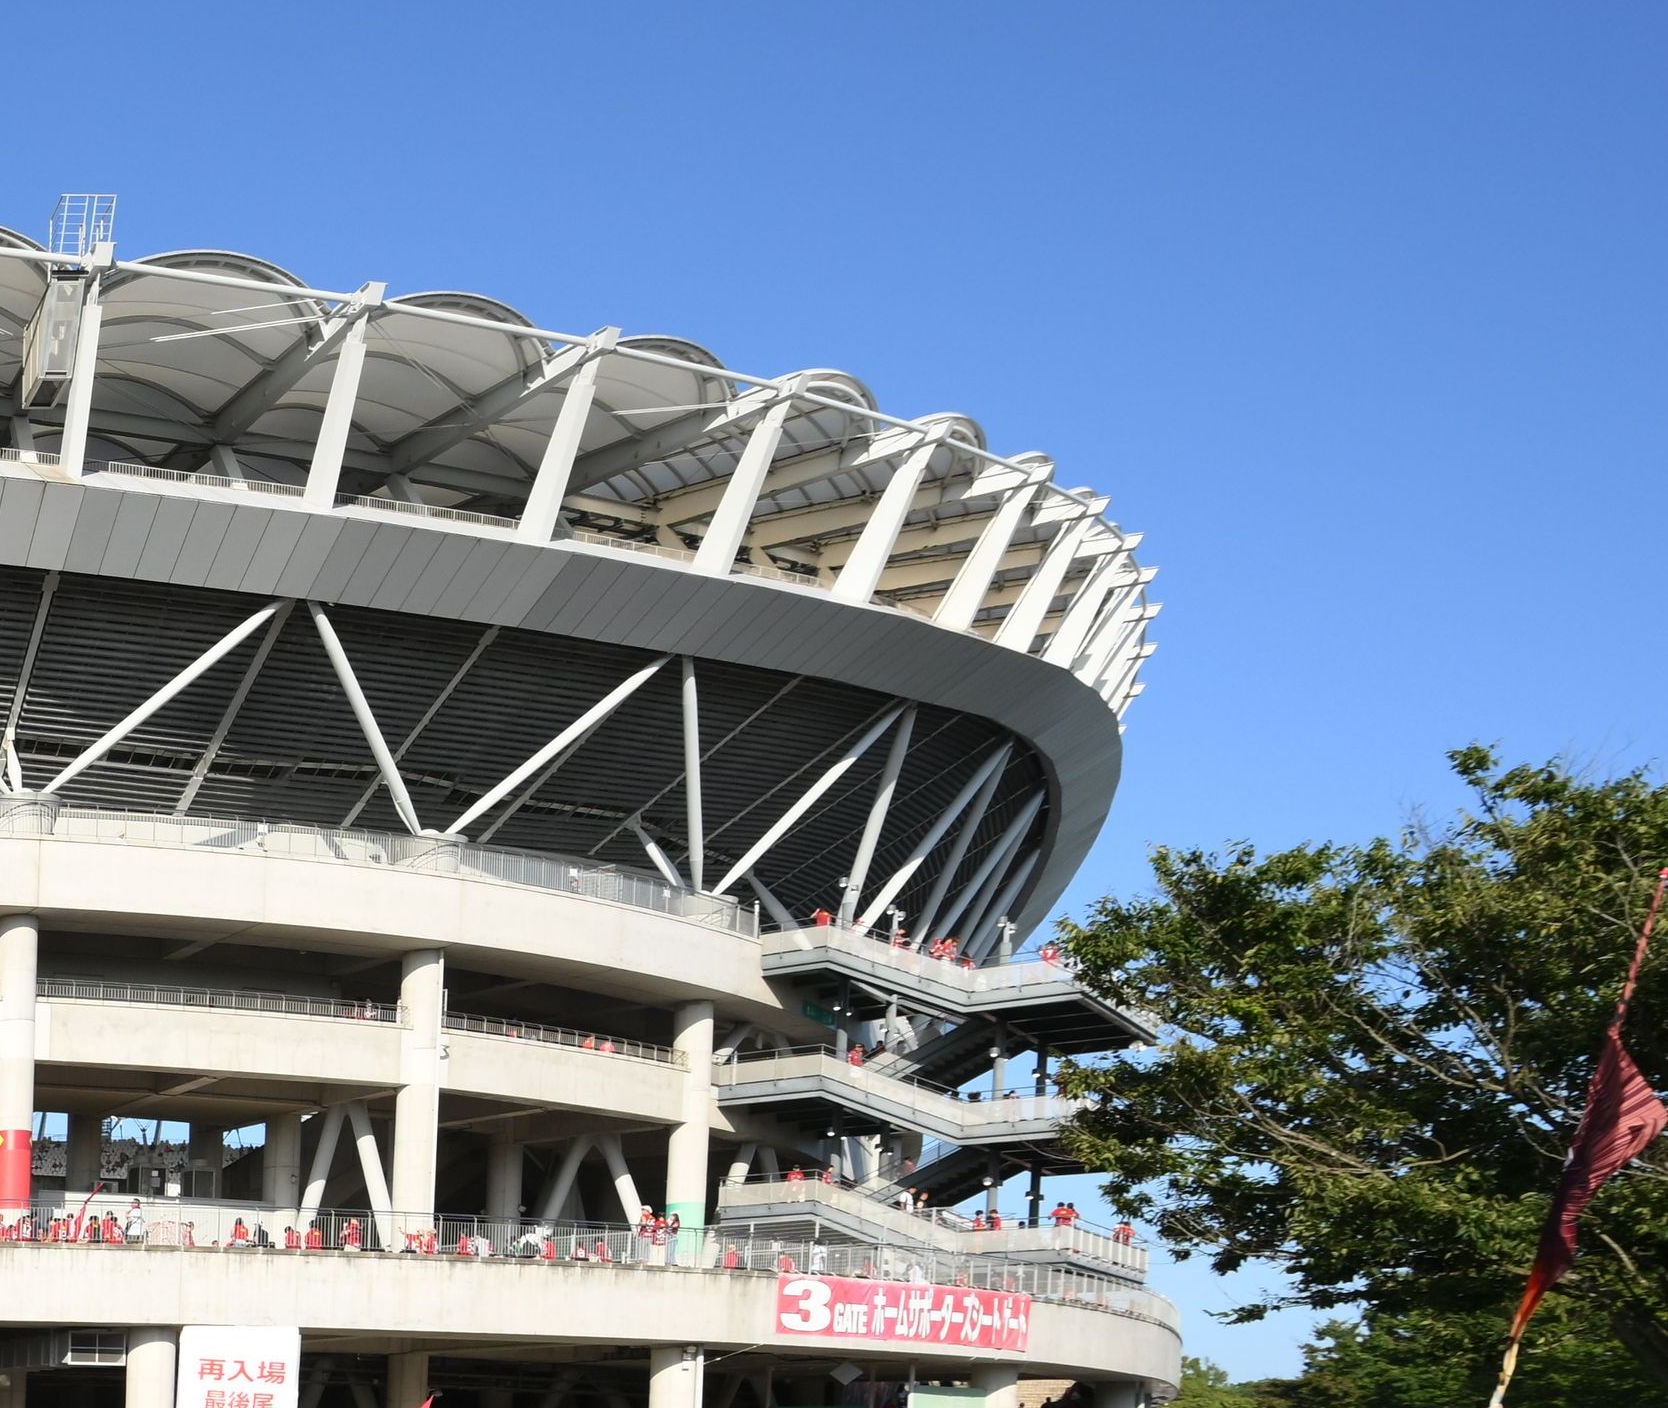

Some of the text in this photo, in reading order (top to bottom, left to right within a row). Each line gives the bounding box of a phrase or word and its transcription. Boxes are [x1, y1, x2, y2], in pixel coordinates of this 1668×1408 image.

[780, 1279, 832, 1332] 3
[833, 1303, 869, 1335] GATE
[198, 1358, 287, 1385] 再入場
